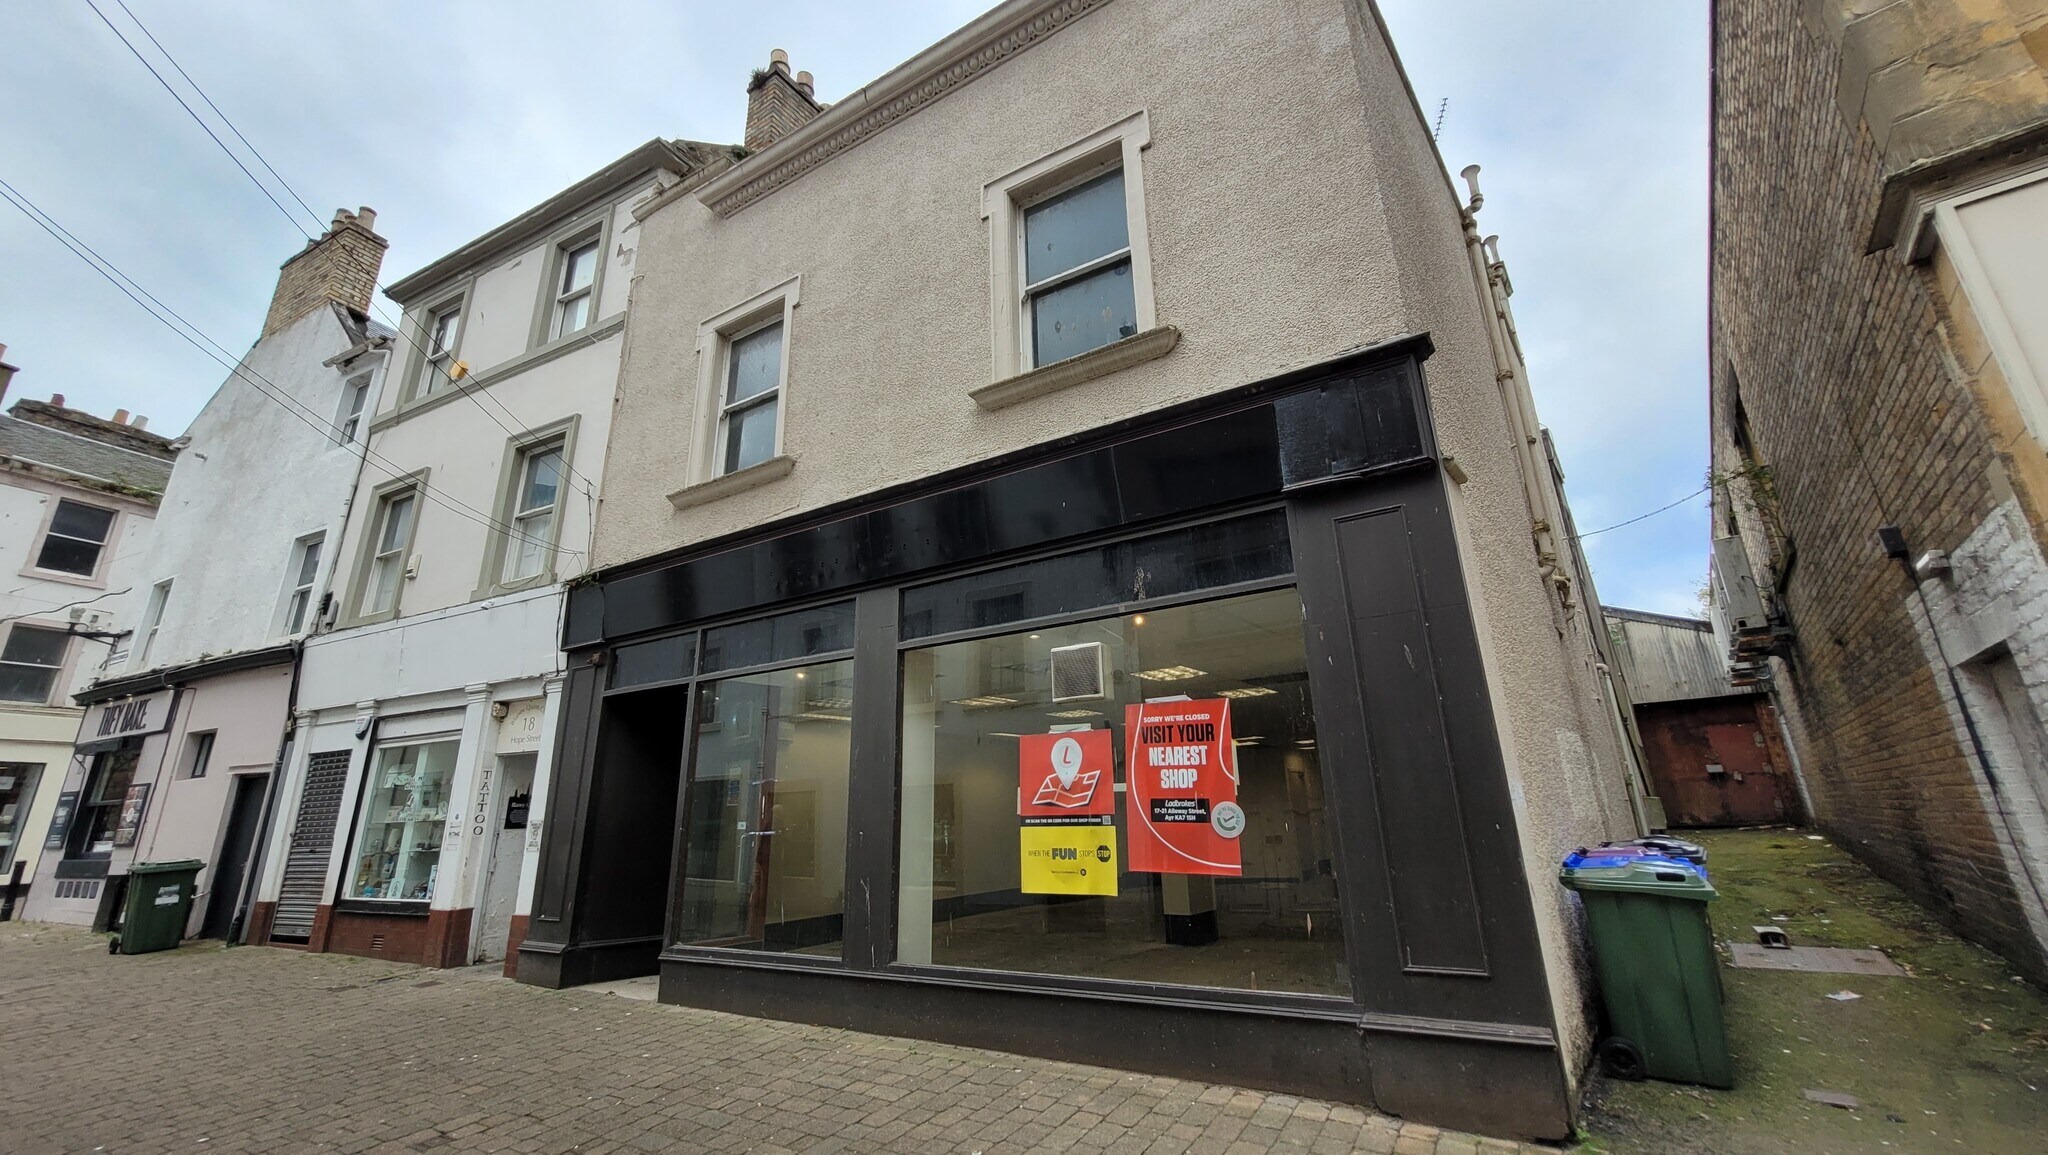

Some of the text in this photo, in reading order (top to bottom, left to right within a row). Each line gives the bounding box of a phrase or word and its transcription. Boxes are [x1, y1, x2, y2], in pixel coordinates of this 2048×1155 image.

[97, 703, 126, 737] THEY
[523, 716, 536, 731] 18
[1164, 714, 1184, 722] WE'RE
[511, 736, 525, 745] Hope
[1141, 723, 1215, 744] VISIT YOUR
[1148, 745, 1207, 766] NEAREST
[1160, 768, 1198, 788] SHOP
[473, 770, 492, 835] TATTOO
[1051, 848, 1077, 860] FUN
[1097, 850, 1110, 858] STOP
